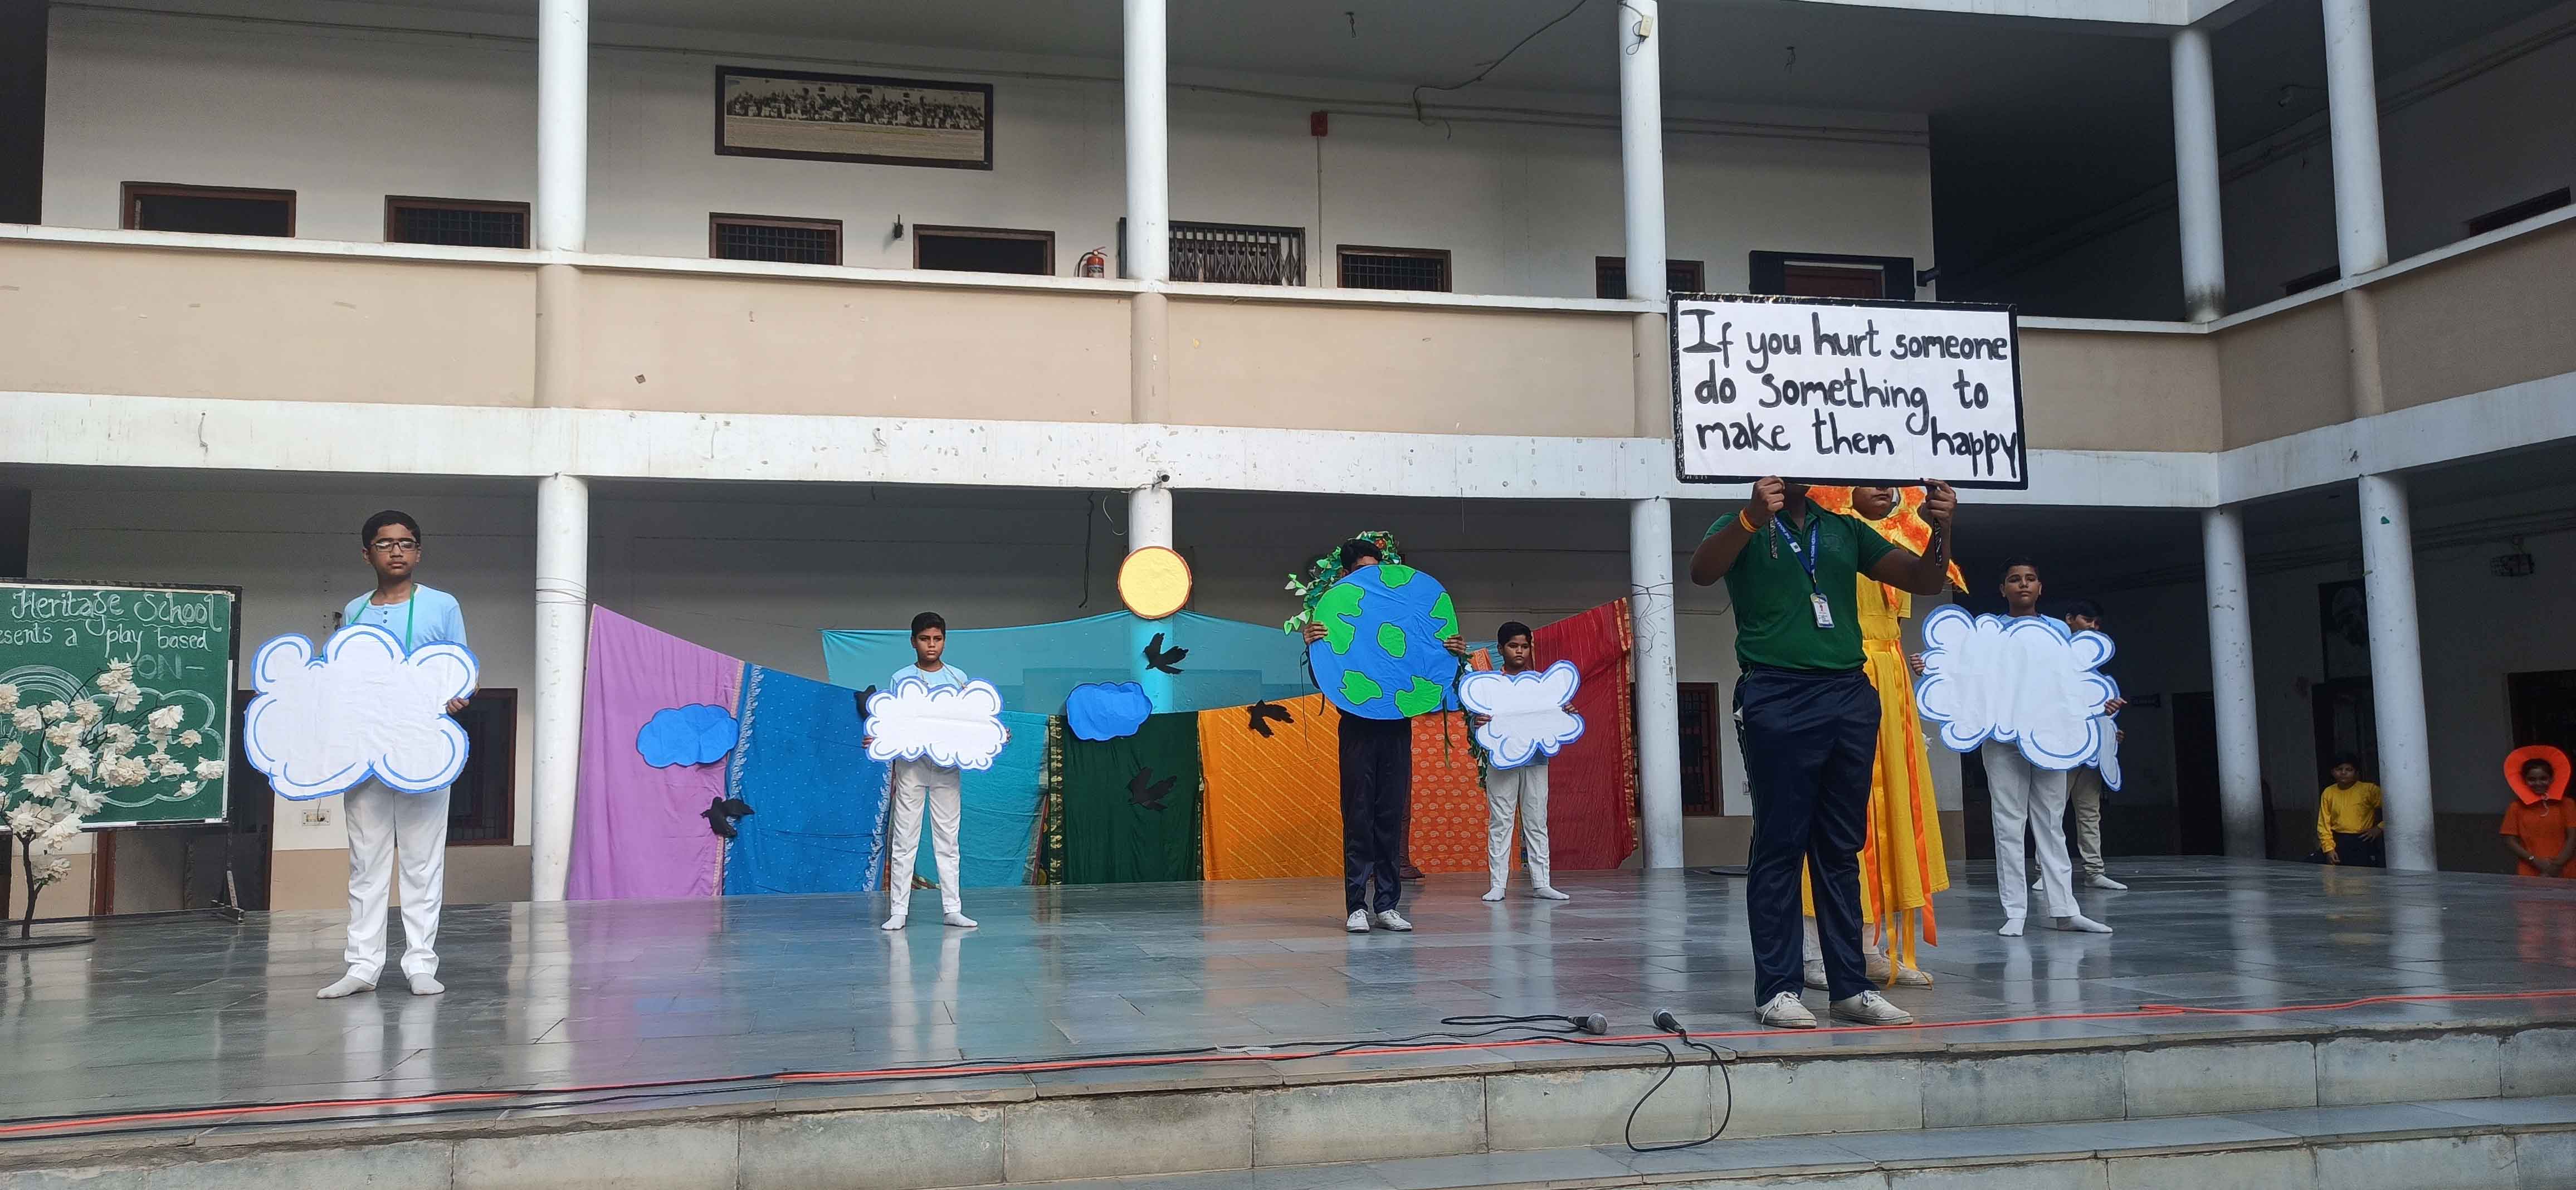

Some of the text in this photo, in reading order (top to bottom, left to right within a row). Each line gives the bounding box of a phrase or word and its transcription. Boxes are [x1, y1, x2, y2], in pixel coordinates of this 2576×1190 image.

[1680, 309, 2008, 373] If you hurt someone
[1695, 359, 1736, 404] do
[1953, 369, 1989, 409] to
[1695, 408, 2017, 479] make them happy
[11, 589, 222, 636] Heritage School
[65, 627, 78, 647] a
[104, 623, 143, 662] play
[153, 627, 212, 652] based
